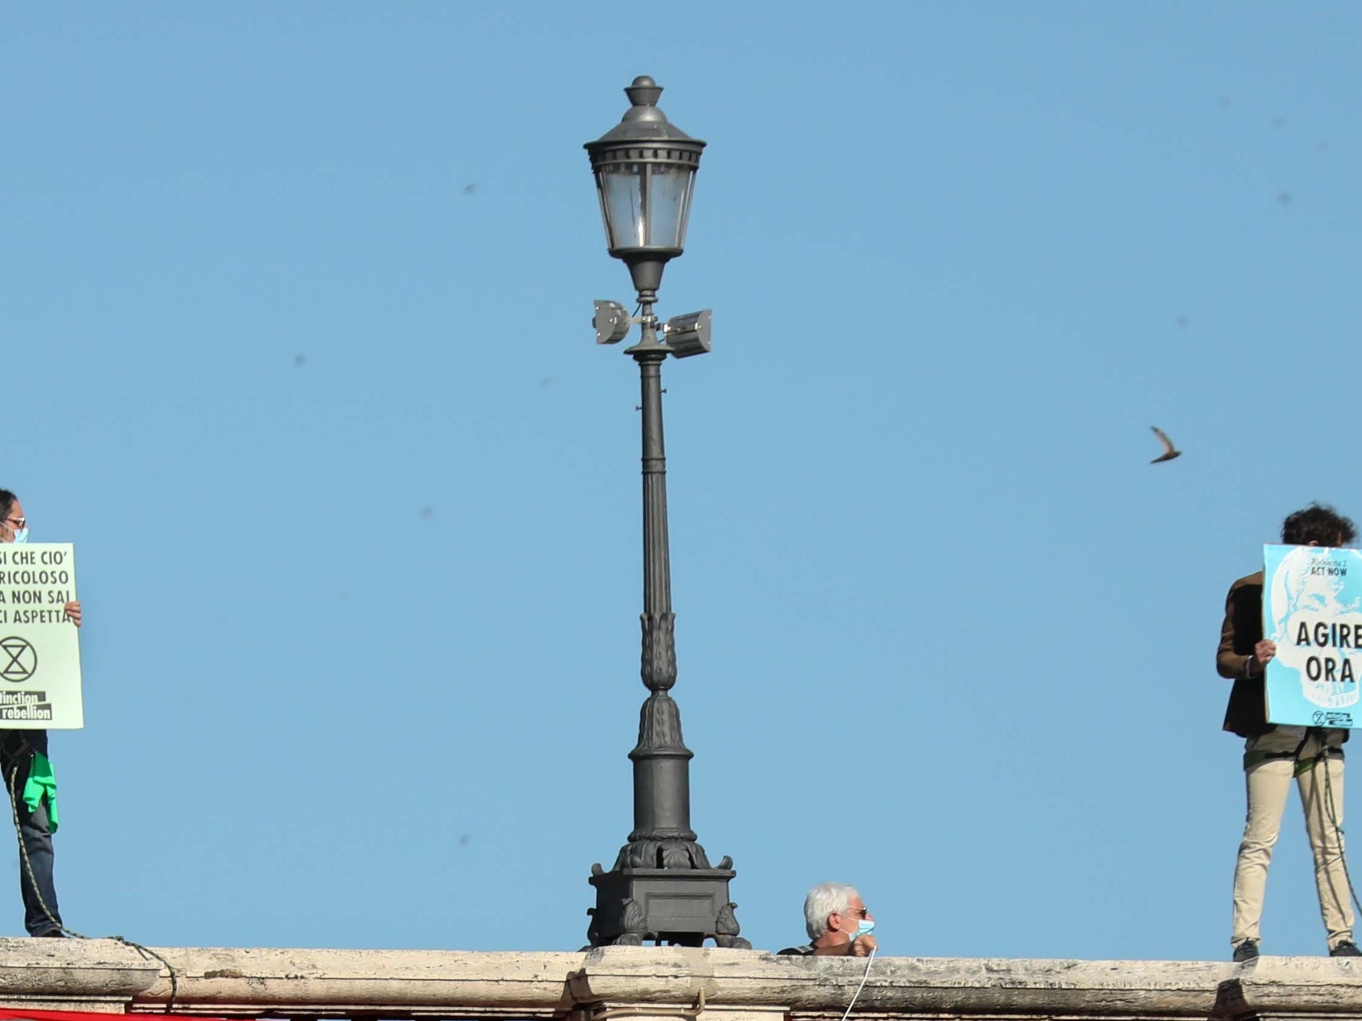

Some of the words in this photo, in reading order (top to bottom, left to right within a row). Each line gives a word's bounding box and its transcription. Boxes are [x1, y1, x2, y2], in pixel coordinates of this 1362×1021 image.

[12, 551, 36, 565] CHE
[1310, 567, 1325, 575] ACT
[1328, 568, 1347, 576] NOW
[12, 590, 42, 604] NON
[48, 591, 70, 604] SAI
[13, 610, 71, 623] ASPETTA
[1306, 656, 1355, 682] ORA
[2, 703, 50, 719] rebellion
